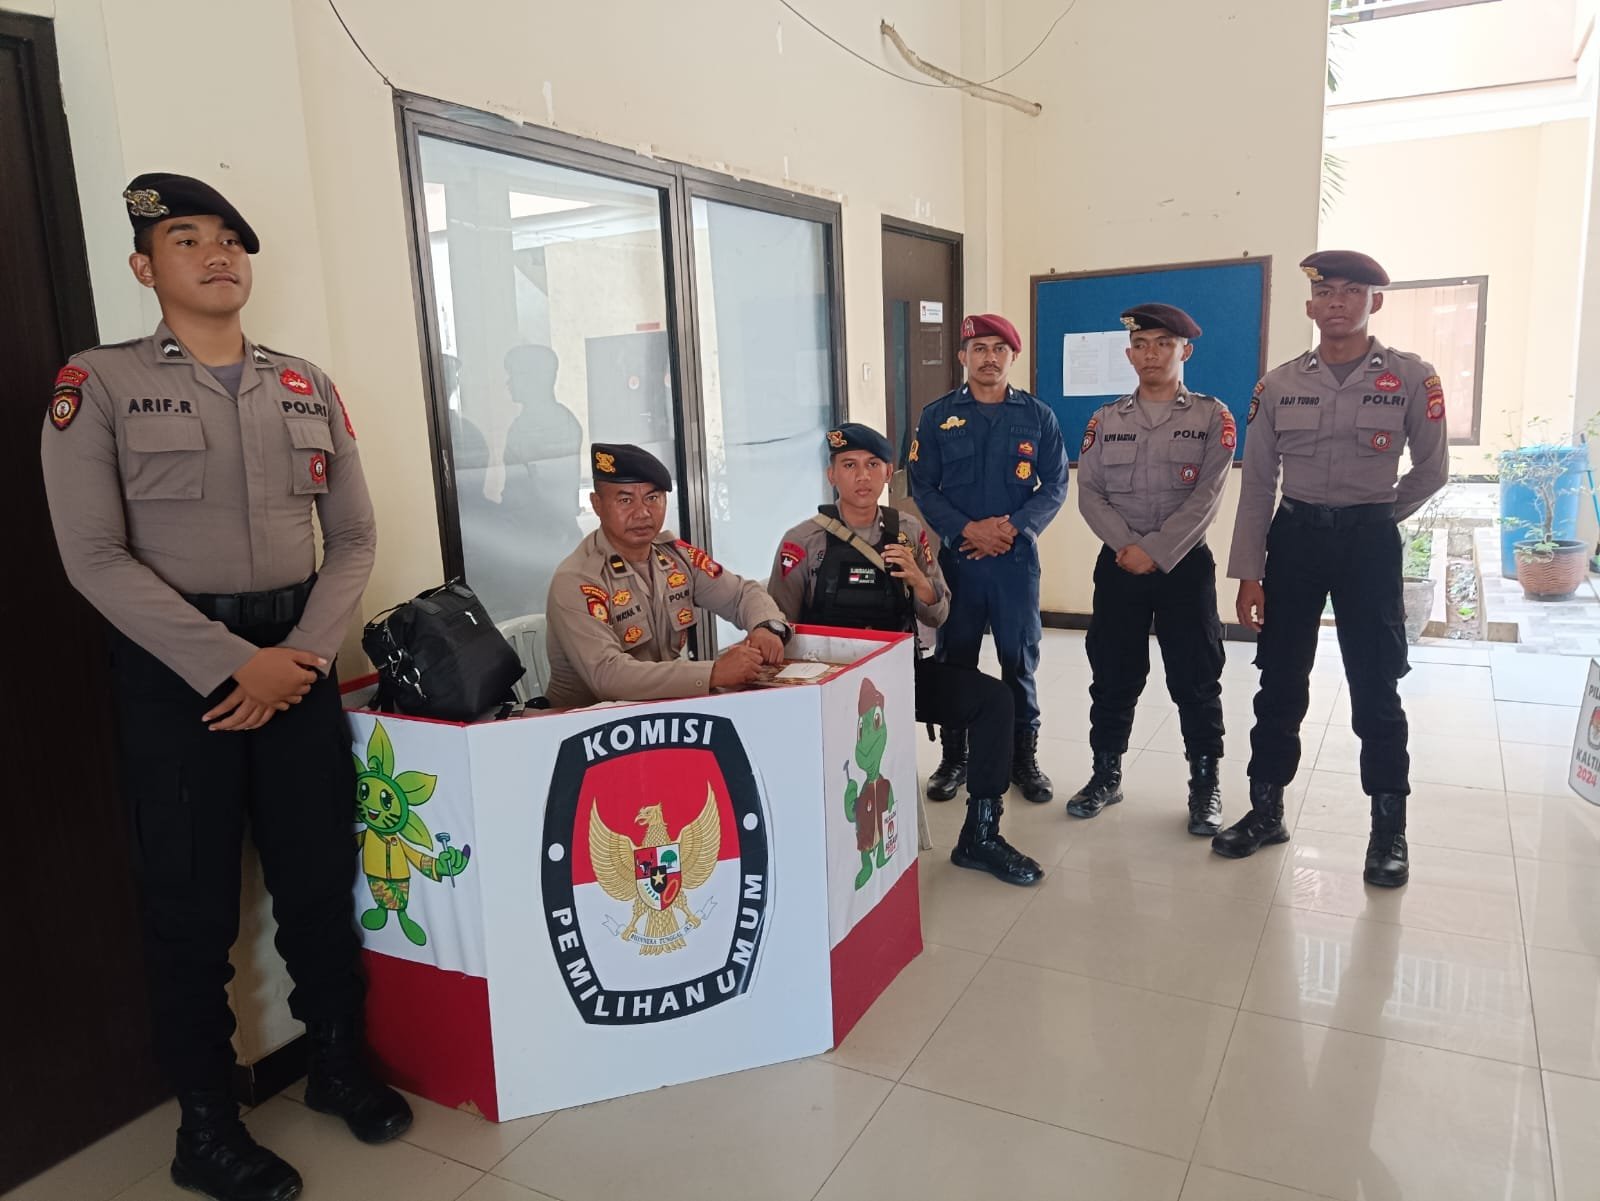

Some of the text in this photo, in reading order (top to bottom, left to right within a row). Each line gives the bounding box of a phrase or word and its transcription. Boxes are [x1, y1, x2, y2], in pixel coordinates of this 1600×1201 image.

[128, 398, 193, 414] ARIF.R
[1363, 395, 1405, 407] POLRI
[281, 401, 328, 418] POLRI
[1173, 430, 1208, 441] POLRI
[1588, 684, 1600, 700] PIL
[583, 718, 714, 761] KOMISI
[1576, 764, 1597, 788] 2024
[552, 873, 763, 1018] PEMILIHAN UMUM
